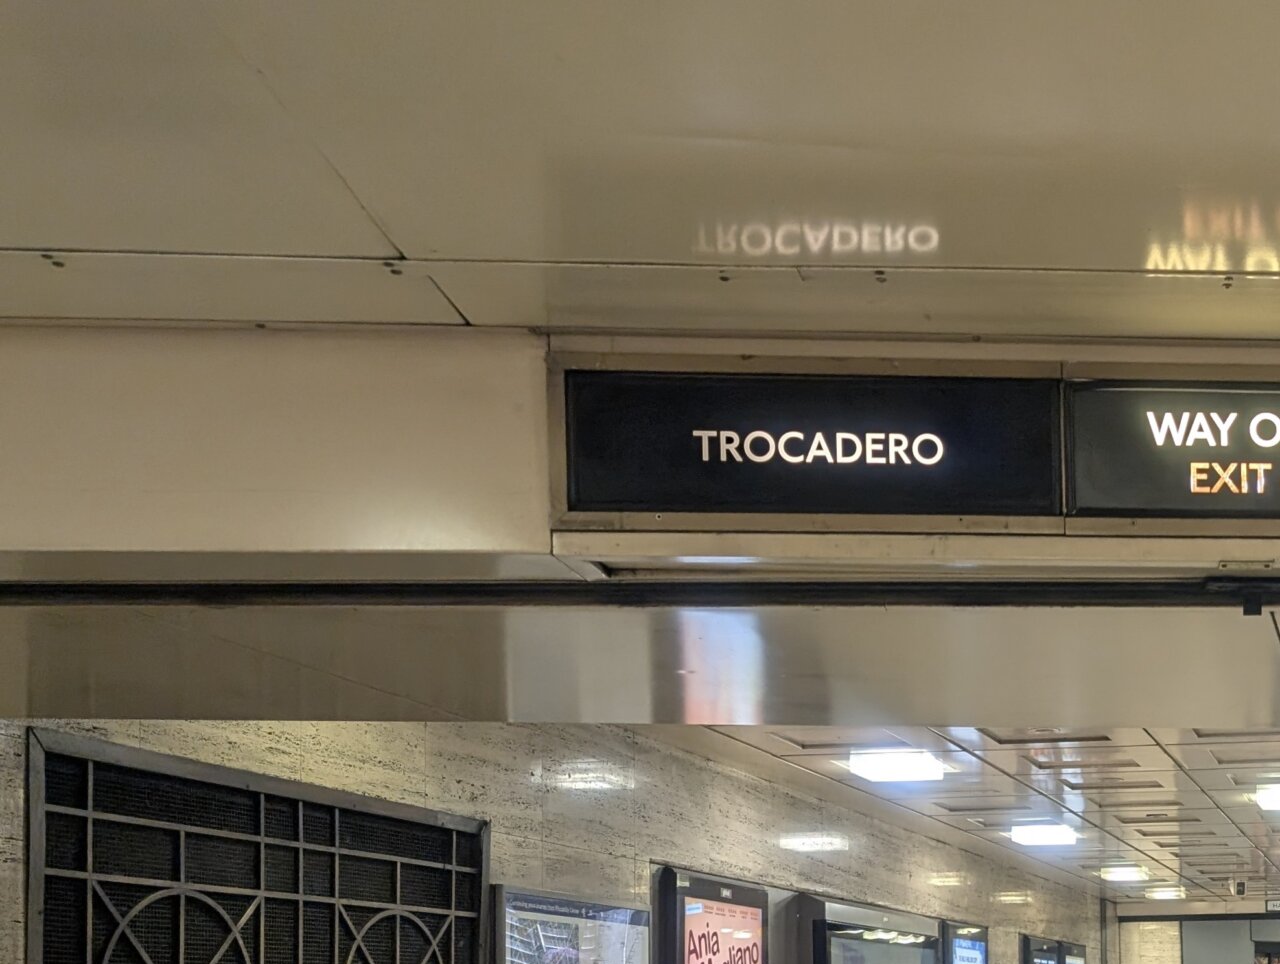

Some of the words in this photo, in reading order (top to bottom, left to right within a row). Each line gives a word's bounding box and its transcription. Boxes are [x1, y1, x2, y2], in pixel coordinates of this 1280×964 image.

[1146, 411, 1238, 447] WAY
[693, 430, 944, 465] TROCADERO
[1190, 462, 1272, 494] EXIT
[687, 922, 720, 964] Ania
